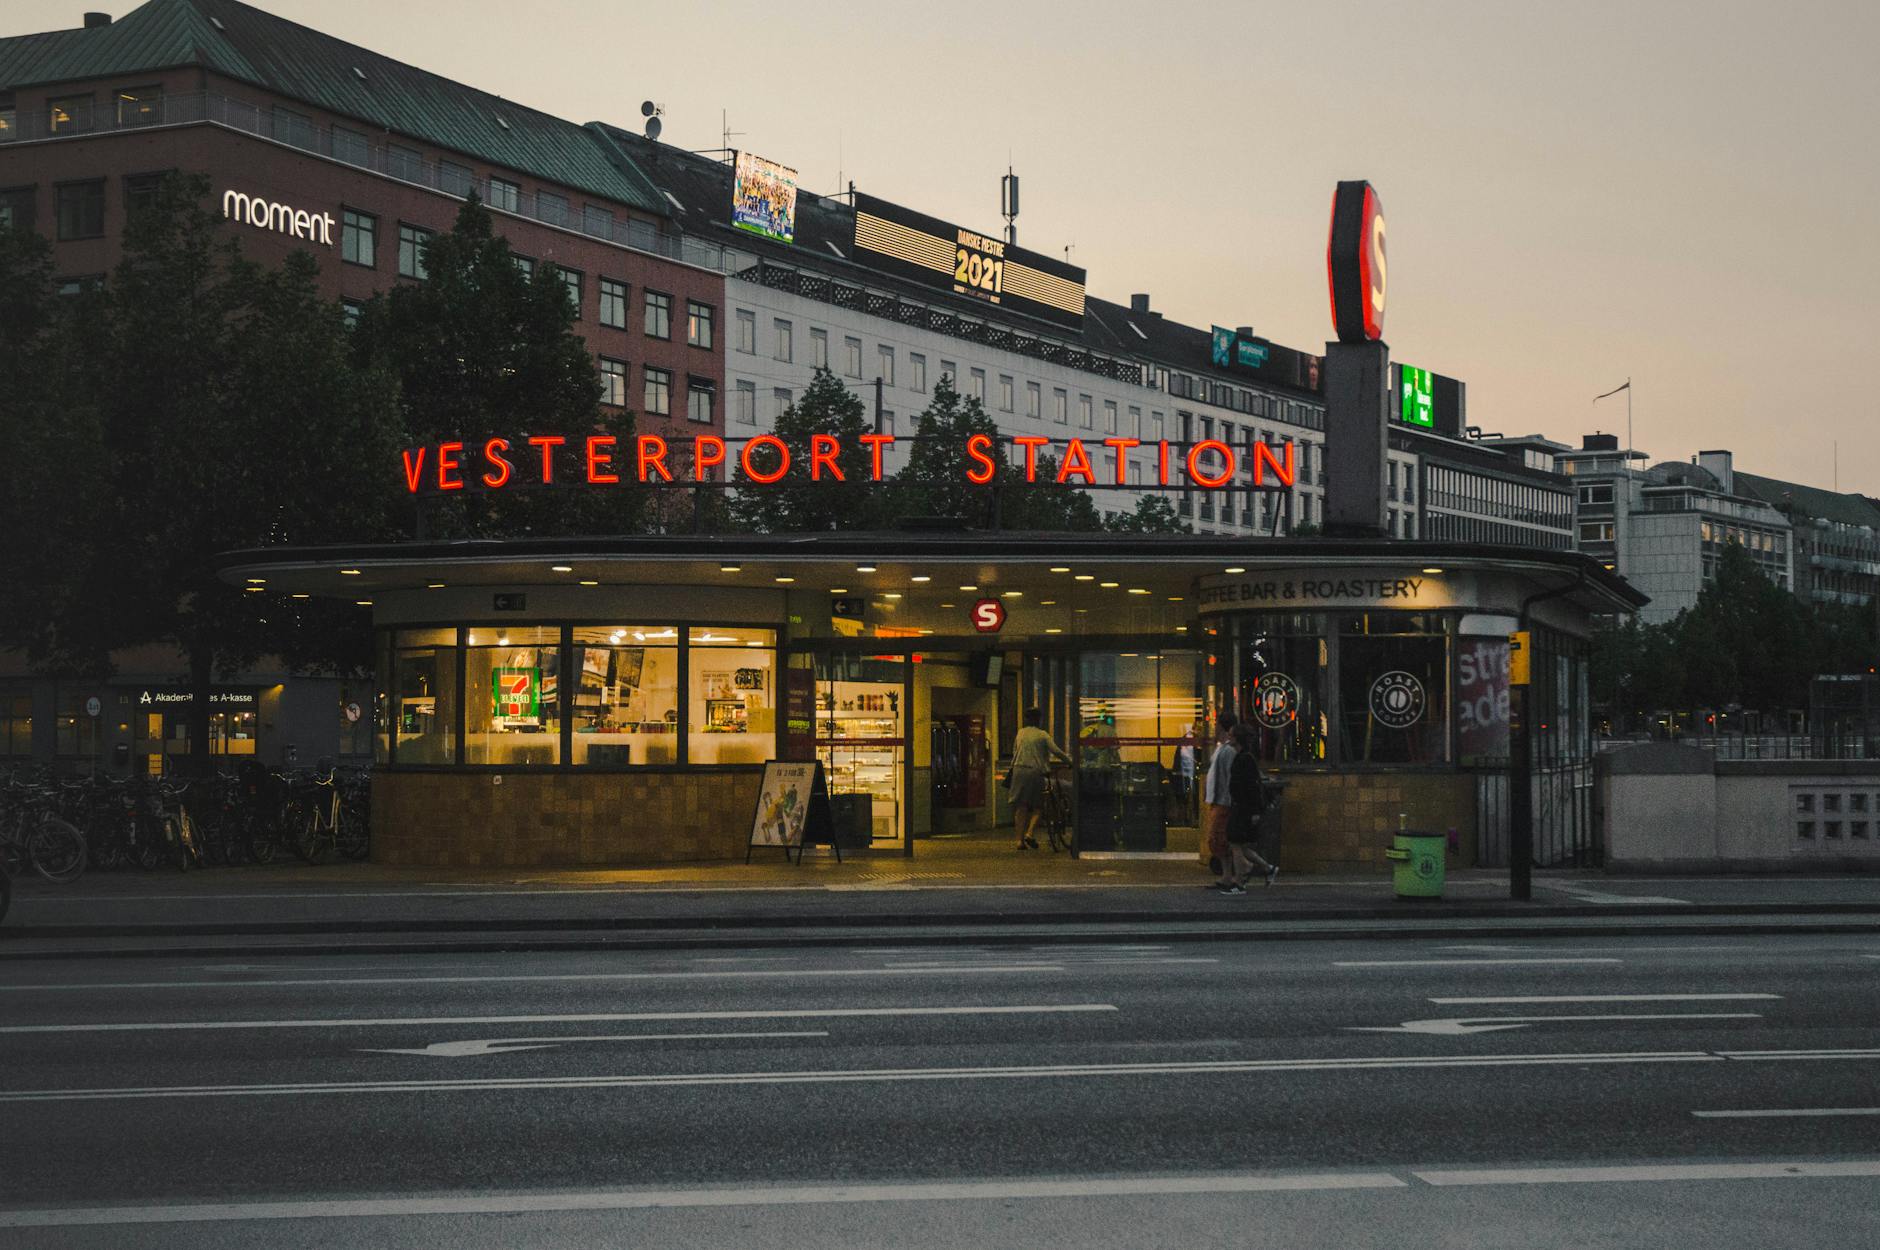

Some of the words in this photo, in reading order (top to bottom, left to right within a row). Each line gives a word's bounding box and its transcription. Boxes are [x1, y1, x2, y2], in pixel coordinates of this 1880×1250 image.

[223, 190, 335, 246] moment
[957, 229, 981, 251] DANSKE
[981, 237, 1004, 259] MESTRE
[954, 249, 1003, 293] 2021
[1372, 214, 1386, 313] S
[401, 433, 895, 494] VESTERPORT
[965, 434, 1297, 488] STATION
[1241, 581, 1277, 600] BAR
[1283, 582, 1296, 599] &
[1302, 577, 1423, 600] ROASTERY
[977, 603, 998, 628] S
[220, 693, 253, 702] A-kasse
[500, 675, 529, 716] 7
[1375, 675, 1420, 694] ROAST
